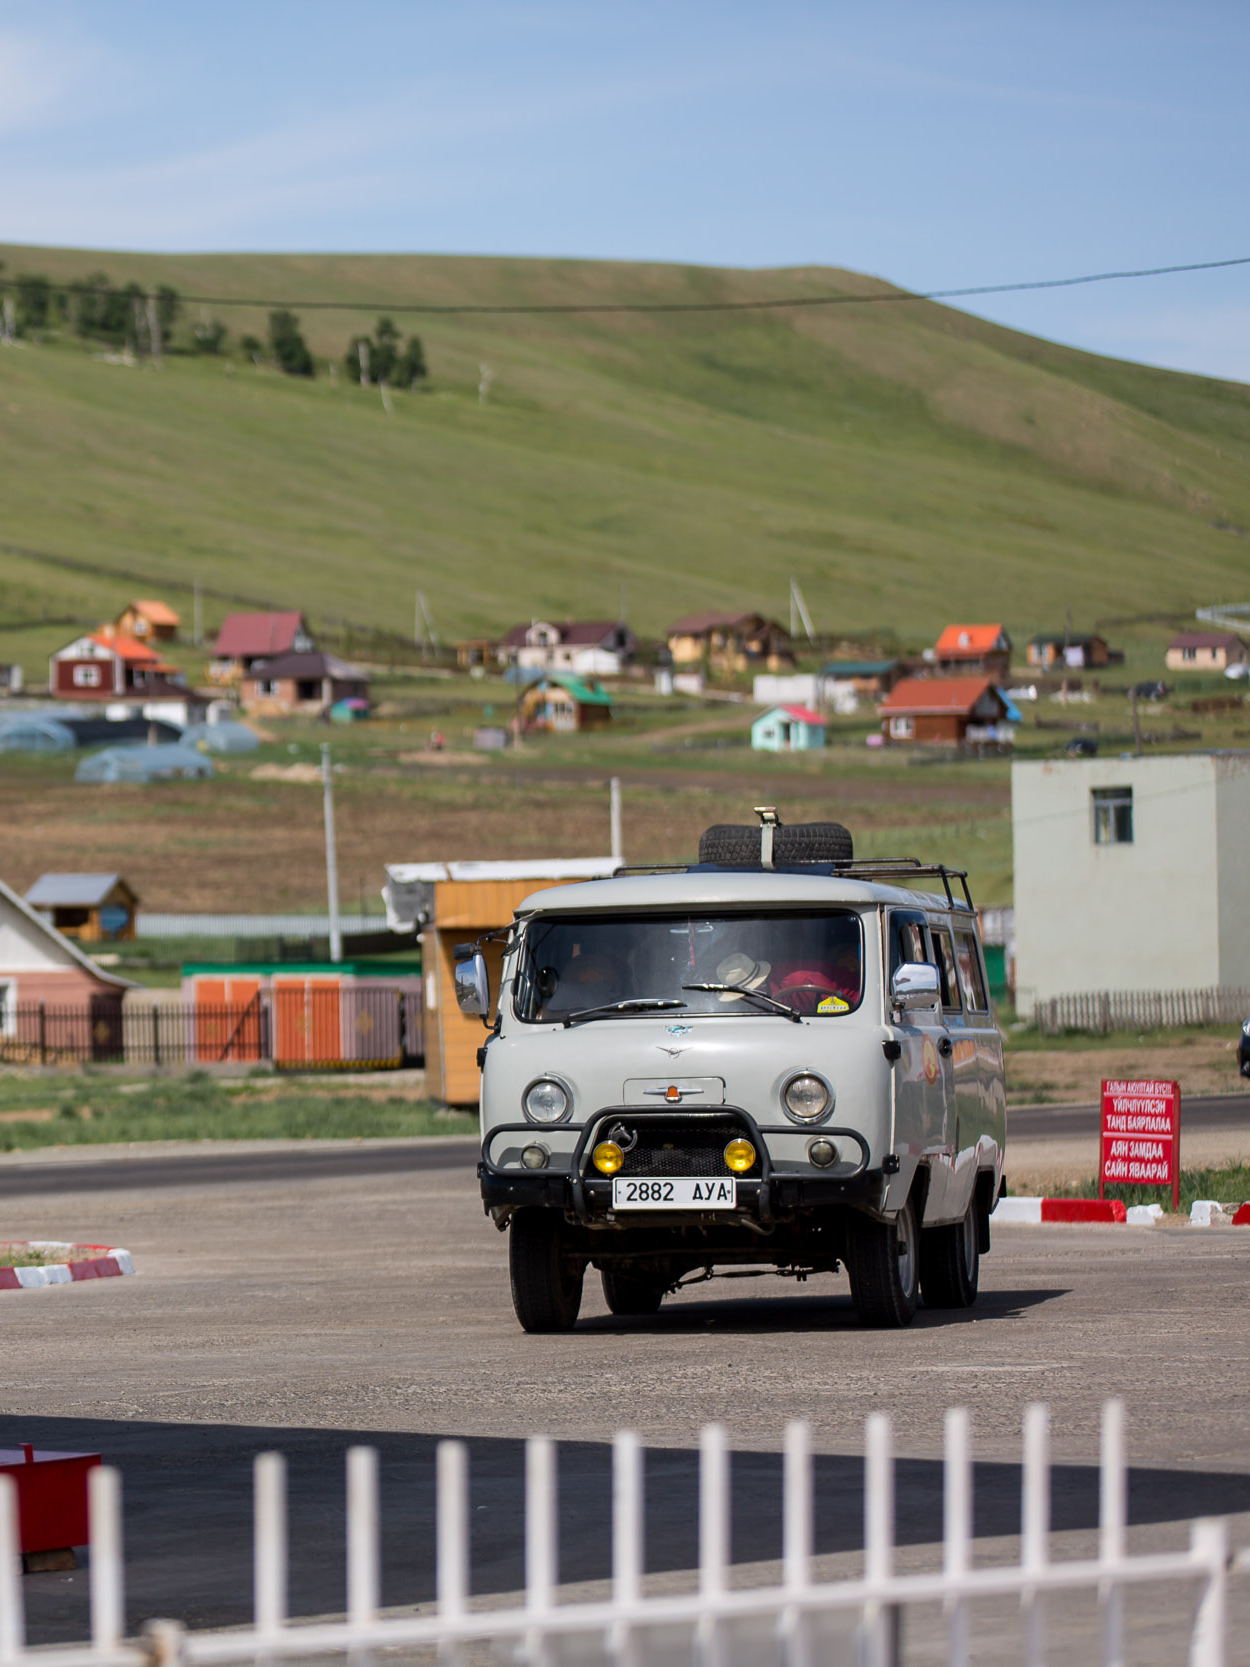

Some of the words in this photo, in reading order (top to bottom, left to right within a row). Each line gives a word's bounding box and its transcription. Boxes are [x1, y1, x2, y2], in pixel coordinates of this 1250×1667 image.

[1106, 1115, 1127, 1132] ТАНД
[1127, 1115, 1171, 1132] БАЯРЛАЛАА
[1110, 1141, 1128, 1157] АЯН
[1129, 1142, 1163, 1160] ЗАМДАА
[1104, 1159, 1128, 1177] САЙН
[1128, 1161, 1168, 1179] ЯВААРАЙ
[626, 1182, 674, 1201] 2882
